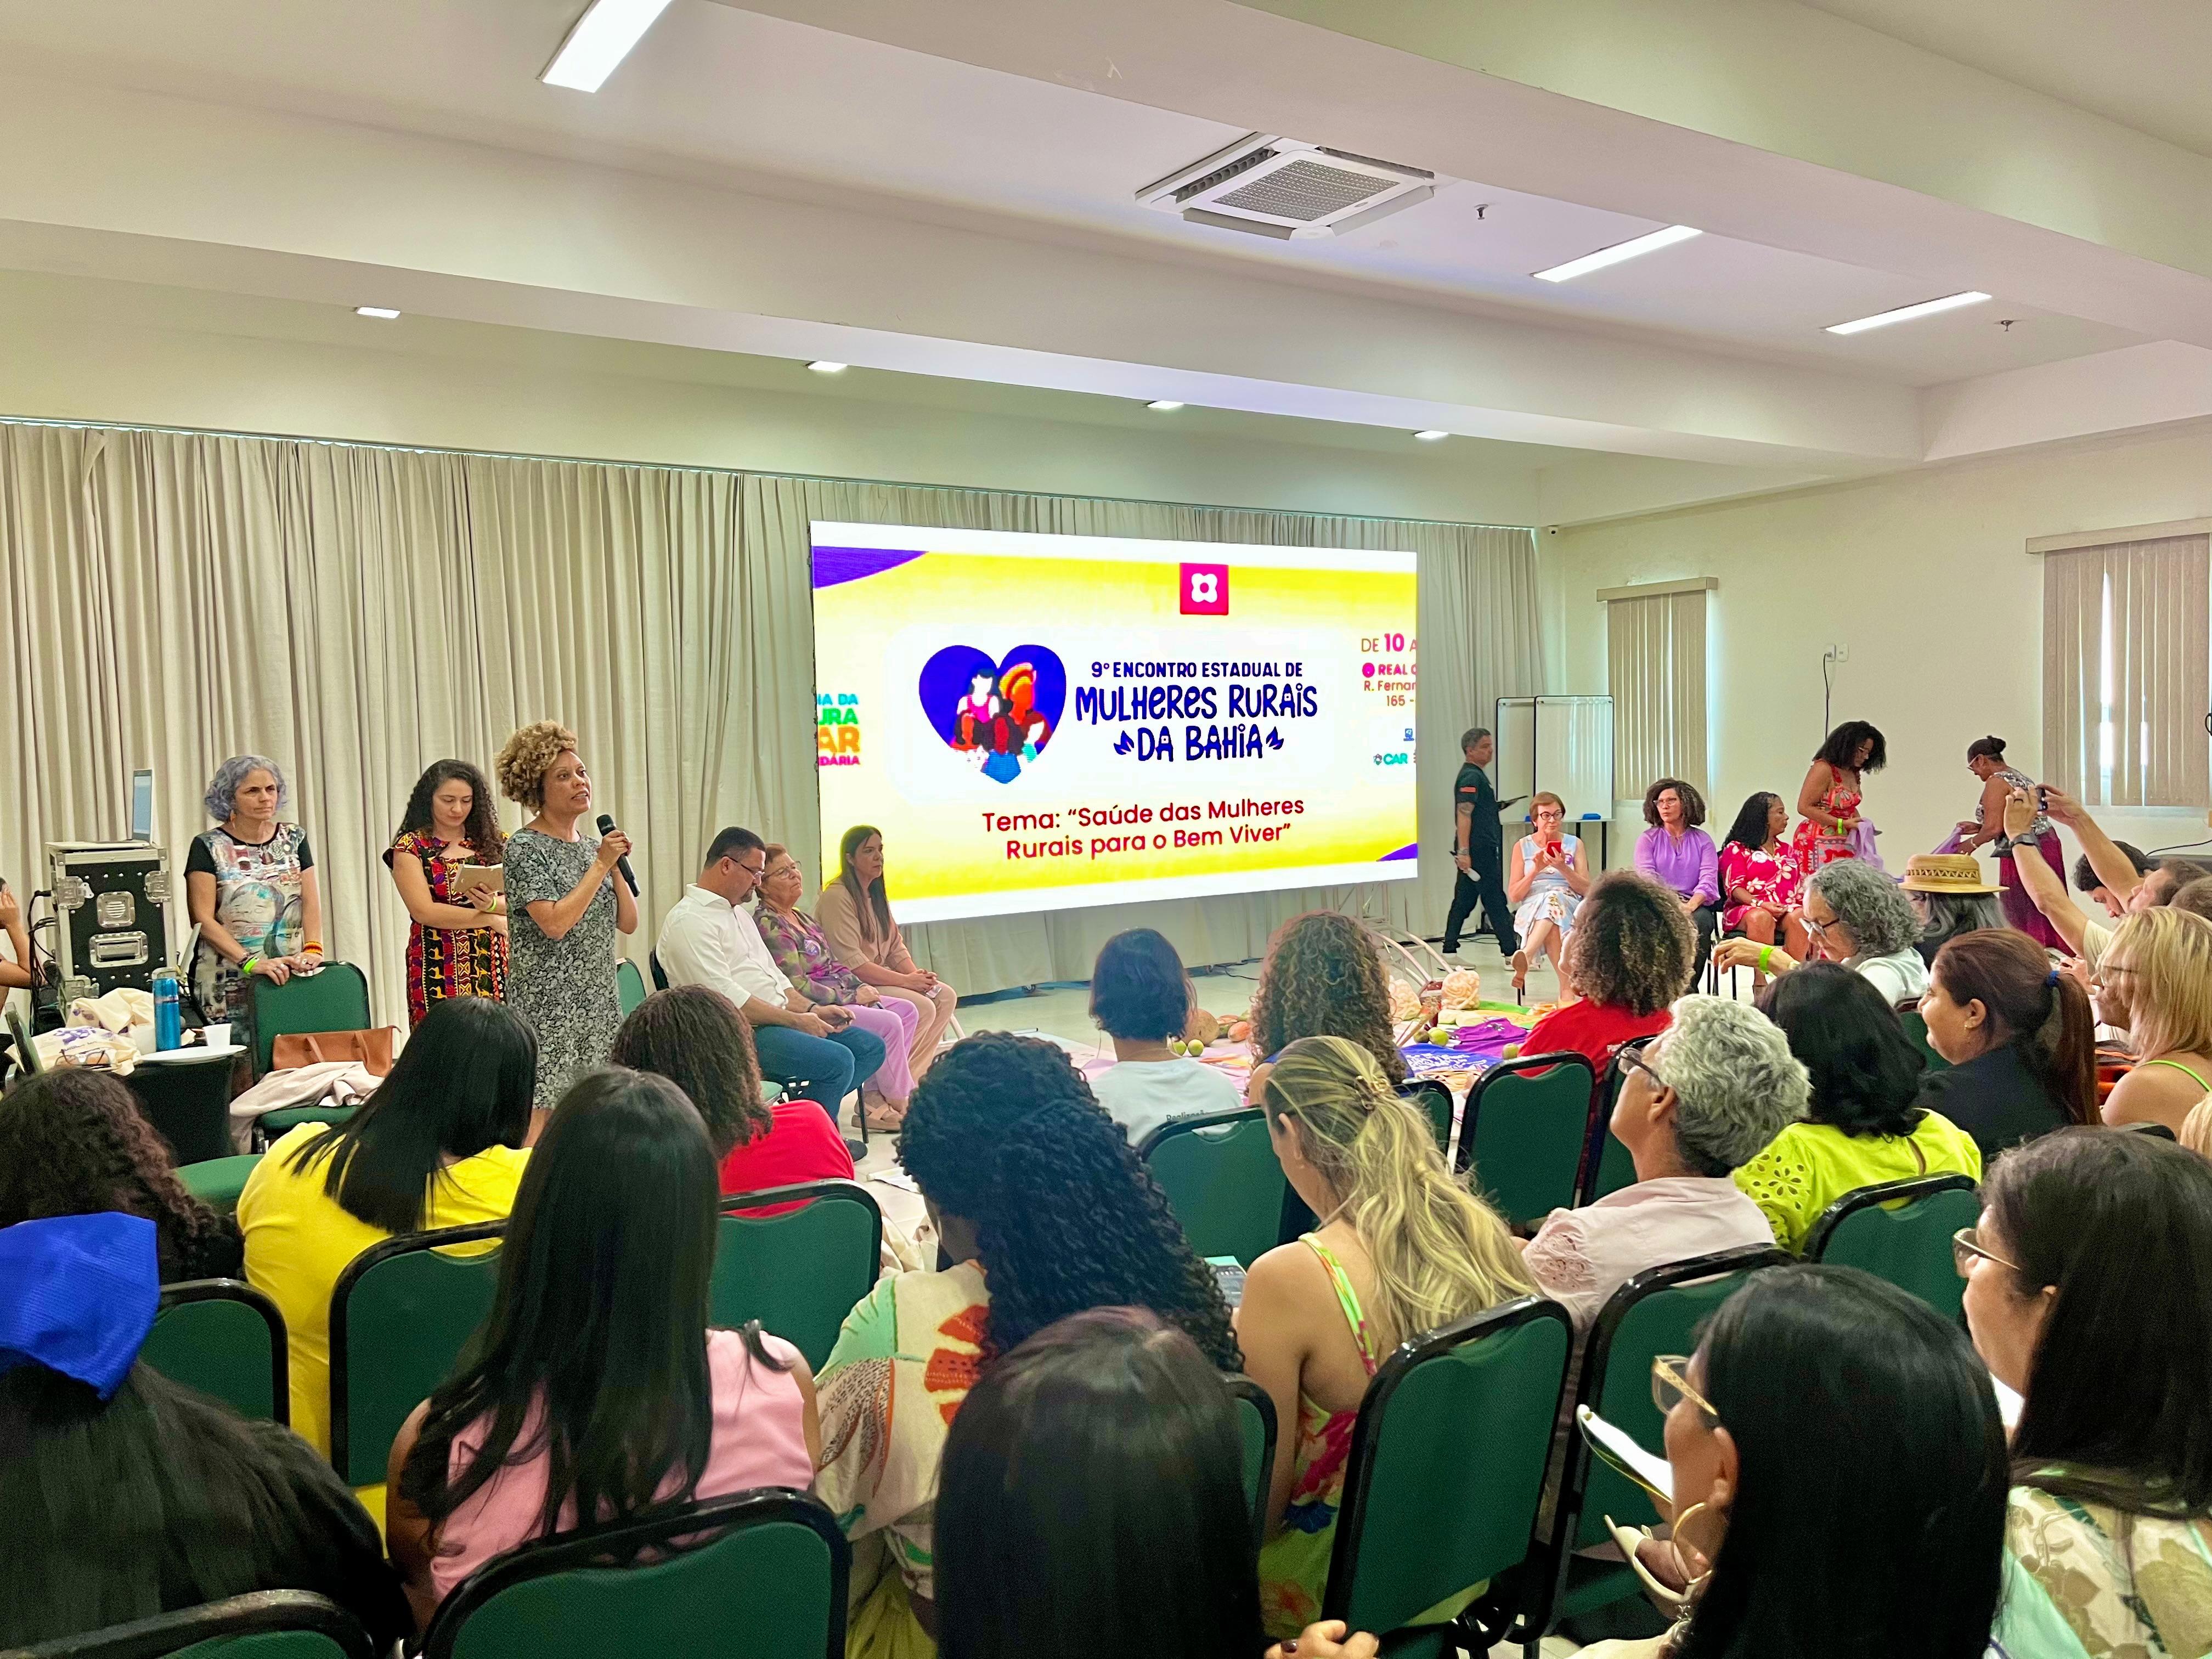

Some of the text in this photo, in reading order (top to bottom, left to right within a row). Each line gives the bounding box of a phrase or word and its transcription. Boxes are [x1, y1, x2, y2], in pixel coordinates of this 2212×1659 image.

[1361, 638, 1379, 652] DE
[1384, 633, 1404, 652] 10
[1114, 662, 1197, 678] ENCONTRO
[1203, 662, 1281, 678] ESTADUAL
[1285, 662, 1302, 677] DE
[1378, 664, 1408, 675] REAL
[1364, 680, 1374, 691] R.
[838, 693, 859, 706] DA
[1386, 695, 1406, 707] 165
[1137, 725, 1174, 763] DA
[1383, 753, 1408, 765] CAR
[982, 812, 1060, 832] Tema:
[1159, 802, 1201, 822] das
[1208, 798, 1305, 820] Mulheres
[1007, 834, 1084, 860] Rurais
[1091, 834, 1146, 861] para
[1153, 834, 1167, 849] o
[1174, 830, 1222, 848] Bem
